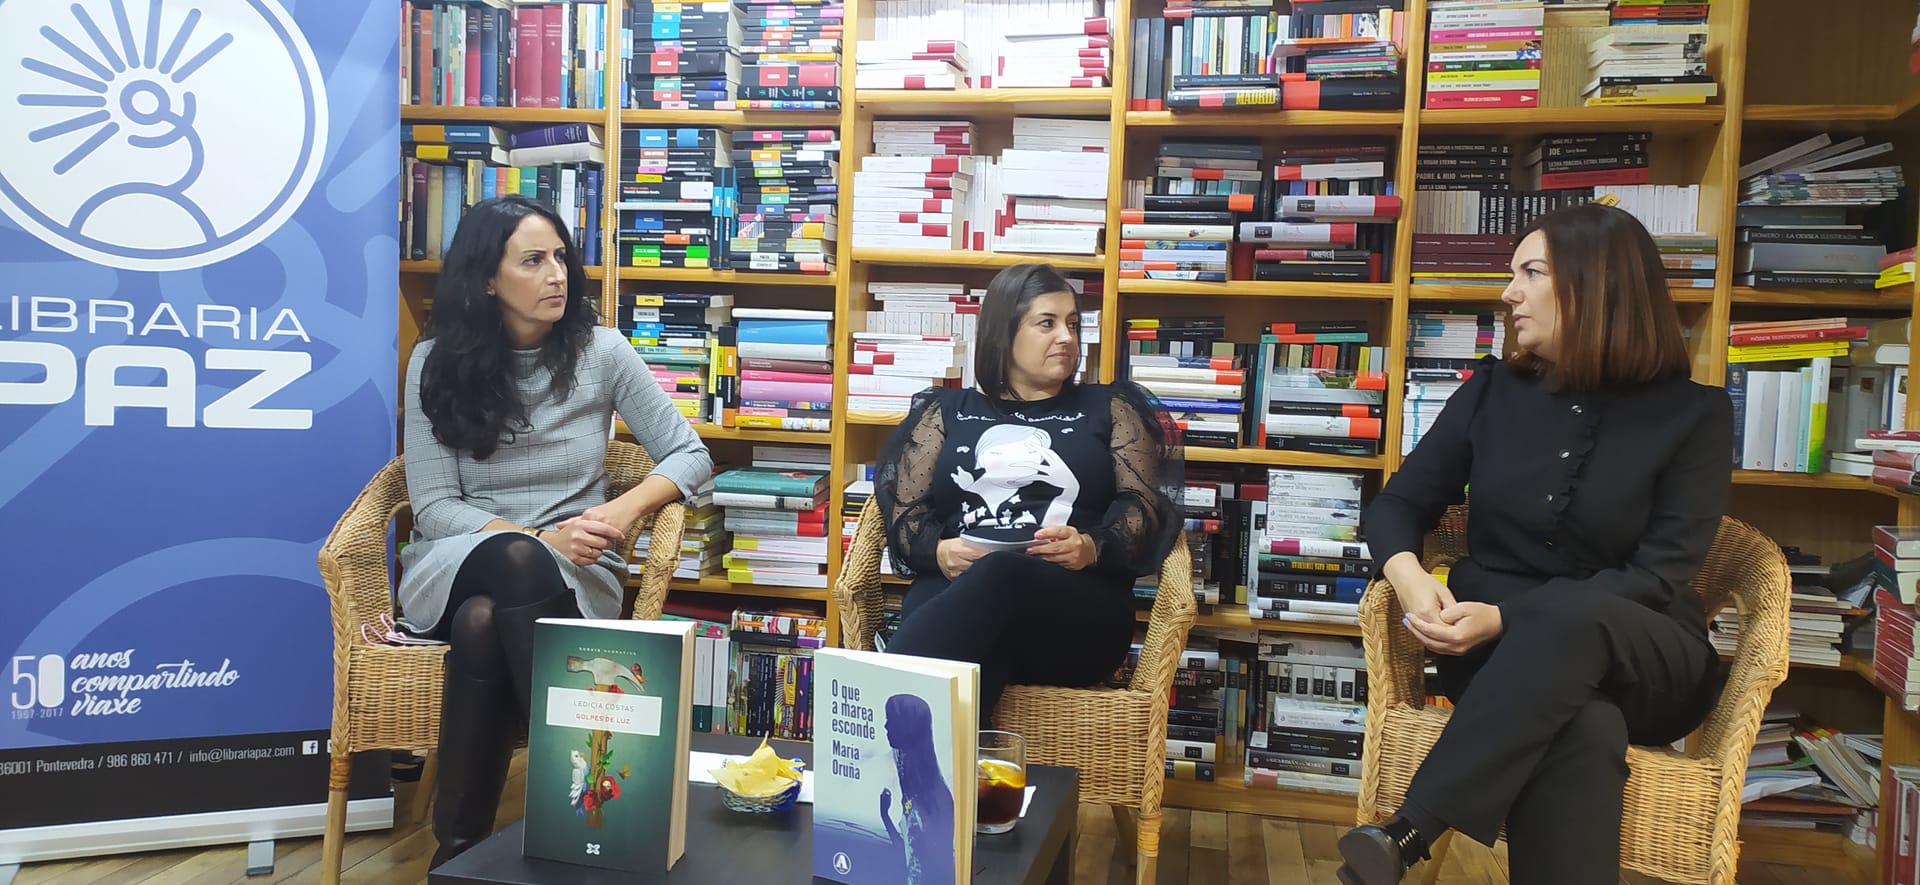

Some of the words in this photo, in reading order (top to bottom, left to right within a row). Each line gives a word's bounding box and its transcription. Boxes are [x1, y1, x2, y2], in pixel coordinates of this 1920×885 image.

[1549, 148, 1561, 156] JOE
[0, 295, 311, 344] IBRARIA
[0, 340, 313, 430] PAZ
[70, 648, 136, 670] anos
[11, 654, 65, 710] 50
[71, 658, 241, 699] compartindo
[831, 679, 838, 697] O
[841, 685, 860, 704] que
[70, 693, 143, 717] viaxe
[574, 699, 603, 709] LEDICIA
[605, 703, 635, 713] COSTAS
[831, 702, 838, 715] a
[841, 703, 874, 722] marea
[576, 713, 604, 722] GOLPES
[832, 719, 876, 740] esconde
[36, 757, 95, 773] Pontevedra
[107, 754, 129, 769] 986
[130, 752, 152, 767] 860
[154, 750, 173, 765] 471
[189, 745, 295, 764] info@librariapaz.com
[832, 759, 861, 780] Oruña
